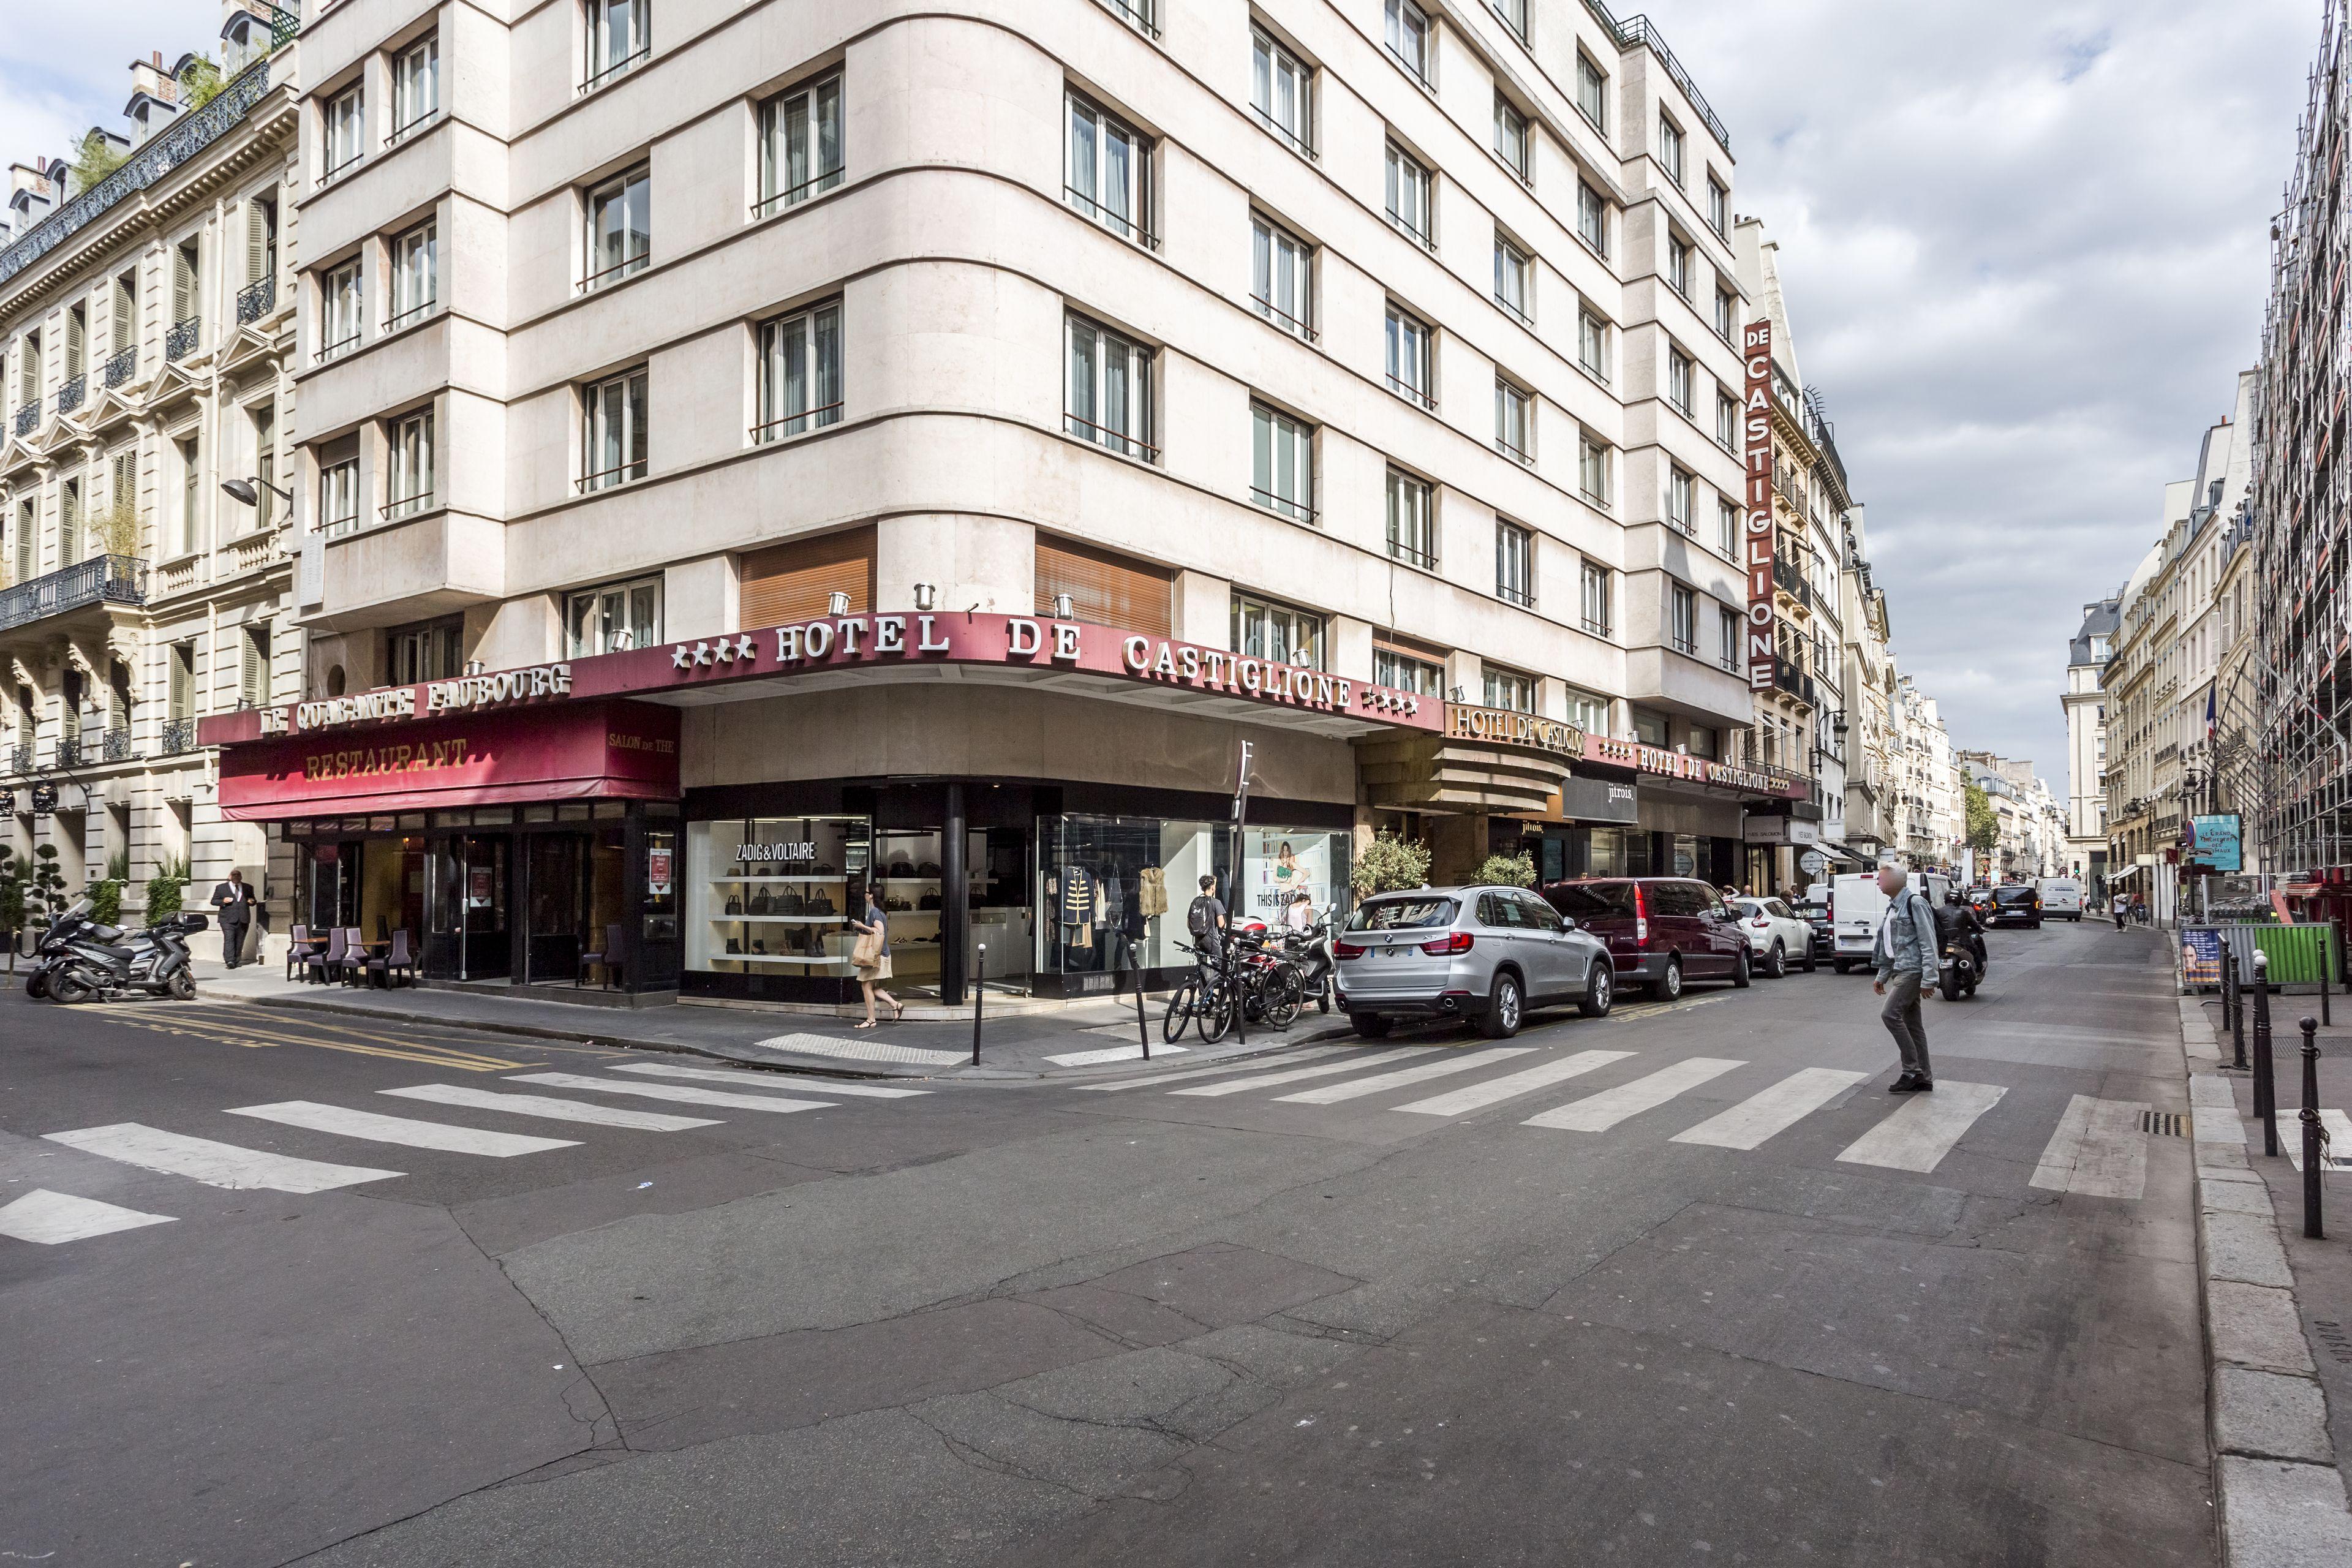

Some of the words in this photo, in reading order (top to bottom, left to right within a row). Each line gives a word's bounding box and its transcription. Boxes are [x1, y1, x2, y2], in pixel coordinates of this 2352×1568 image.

[1747, 328, 1769, 347] DE
[1746, 356, 1773, 688] CASTIGLIONE
[776, 615, 950, 662] HOTEL
[1008, 618, 1081, 660] DE
[1121, 636, 1352, 709] CASTIGLIONE
[260, 707, 289, 733] LE
[296, 688, 415, 730] QUARANTE
[426, 663, 573, 710] FAUBOURG
[609, 733, 641, 749] SALON
[1455, 708, 1512, 737] HOTEL
[1515, 716, 1535, 741] DE
[306, 738, 467, 783] RESTAURANT
[1638, 747, 1679, 773] HOTEL
[1686, 758, 1702, 778] DE
[1708, 763, 1769, 791] CASTIGLIONE
[1608, 783, 1634, 803] jitrois.
[736, 842, 815, 861] ZADIG&VOLTAIRE
[1257, 894, 1272, 907] THIS
[1273, 894, 1280, 907] IS
